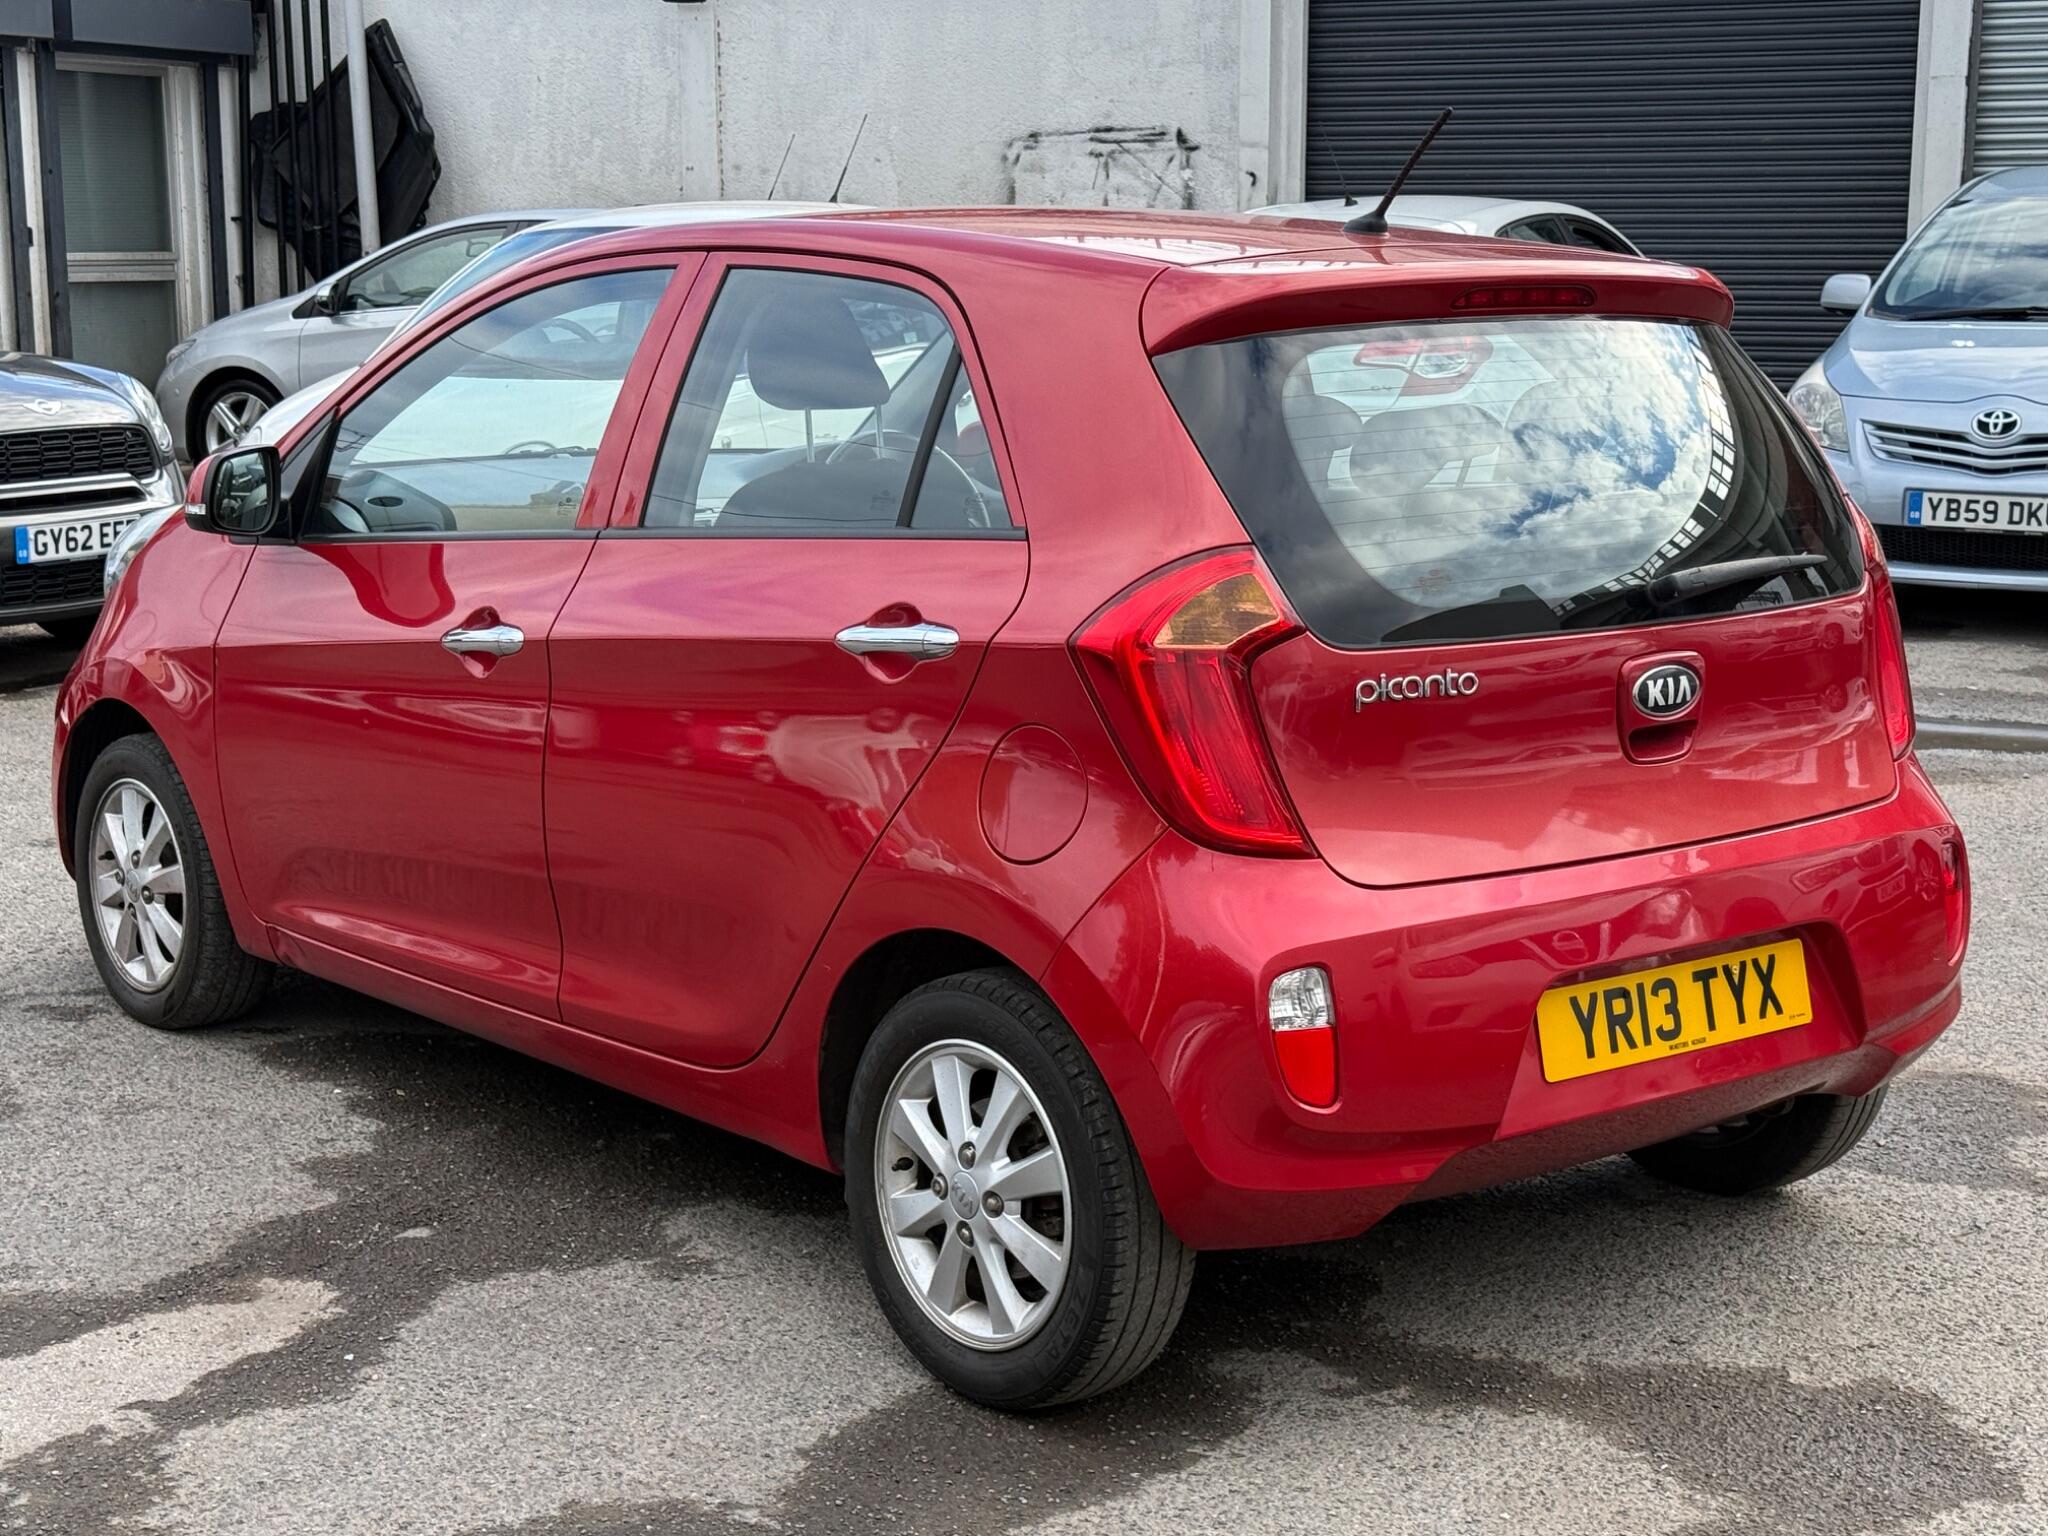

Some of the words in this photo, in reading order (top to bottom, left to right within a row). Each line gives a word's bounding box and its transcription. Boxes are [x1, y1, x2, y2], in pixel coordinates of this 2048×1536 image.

[1928, 497, 1999, 524] YB59
[2007, 501, 2048, 527] DK
[33, 525, 93, 556] GY62
[1355, 668, 1479, 713] picanto
[1645, 674, 1692, 708] KIA
[1569, 977, 1682, 1059] YR13
[1692, 953, 1784, 1032] TYX
